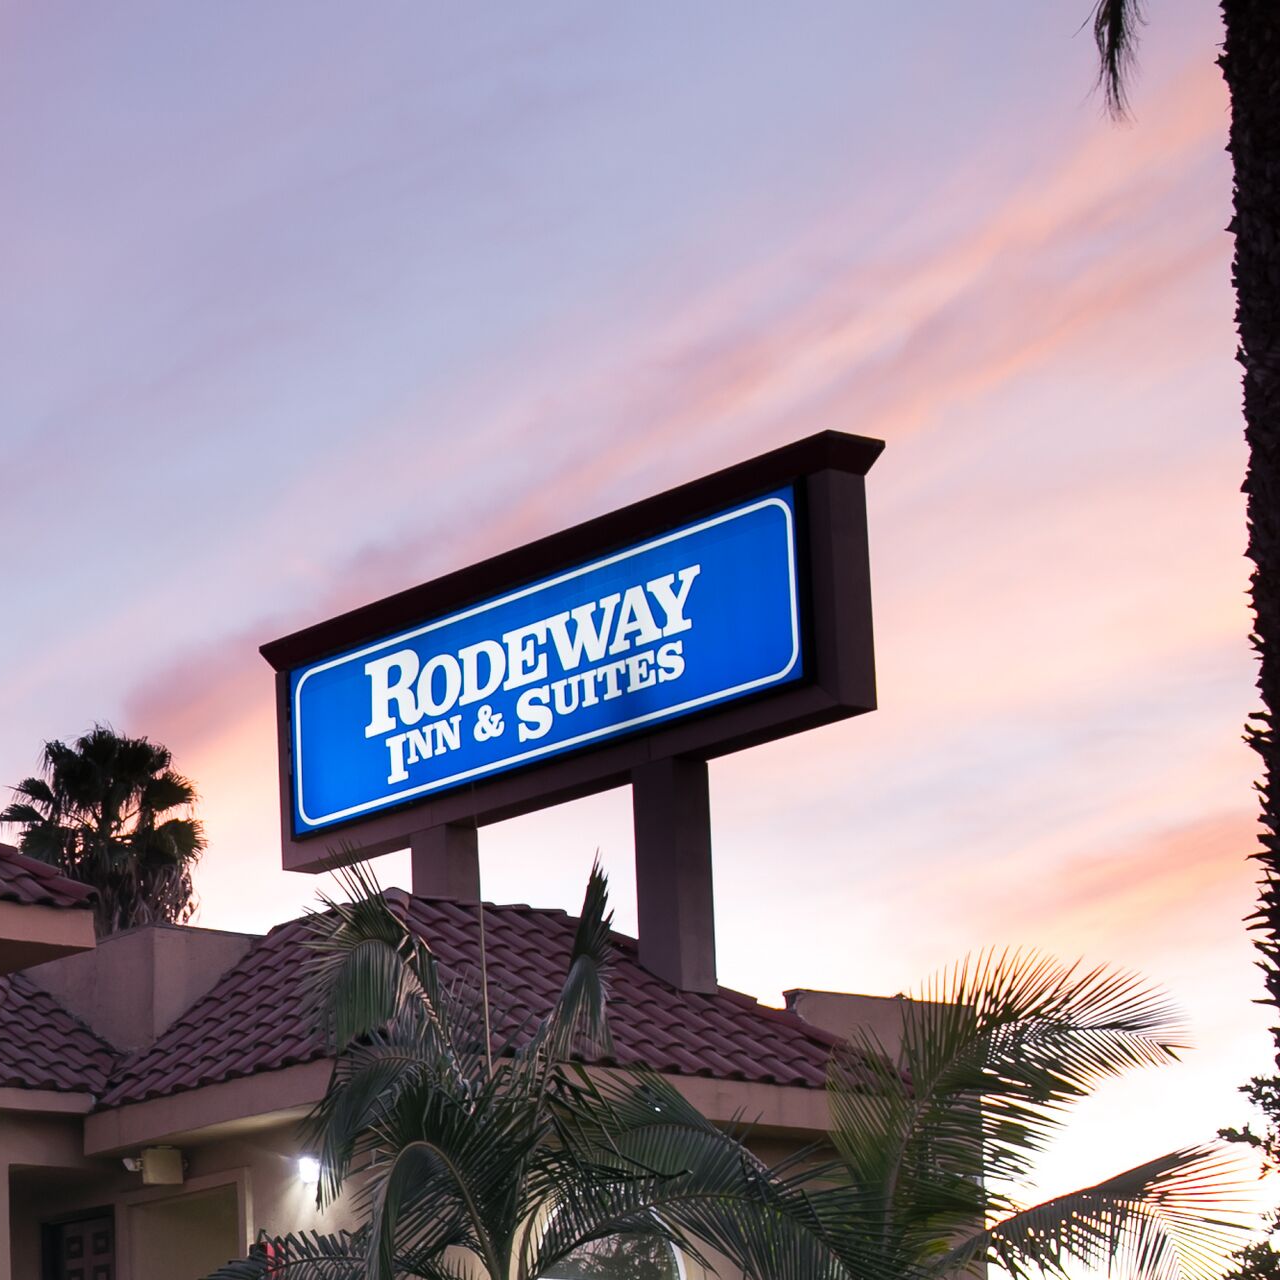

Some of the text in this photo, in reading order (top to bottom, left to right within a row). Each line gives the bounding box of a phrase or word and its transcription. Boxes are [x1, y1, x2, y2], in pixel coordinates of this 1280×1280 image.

[365, 564, 700, 738] RODEWAY
[386, 641, 685, 784] INN & SUITES
